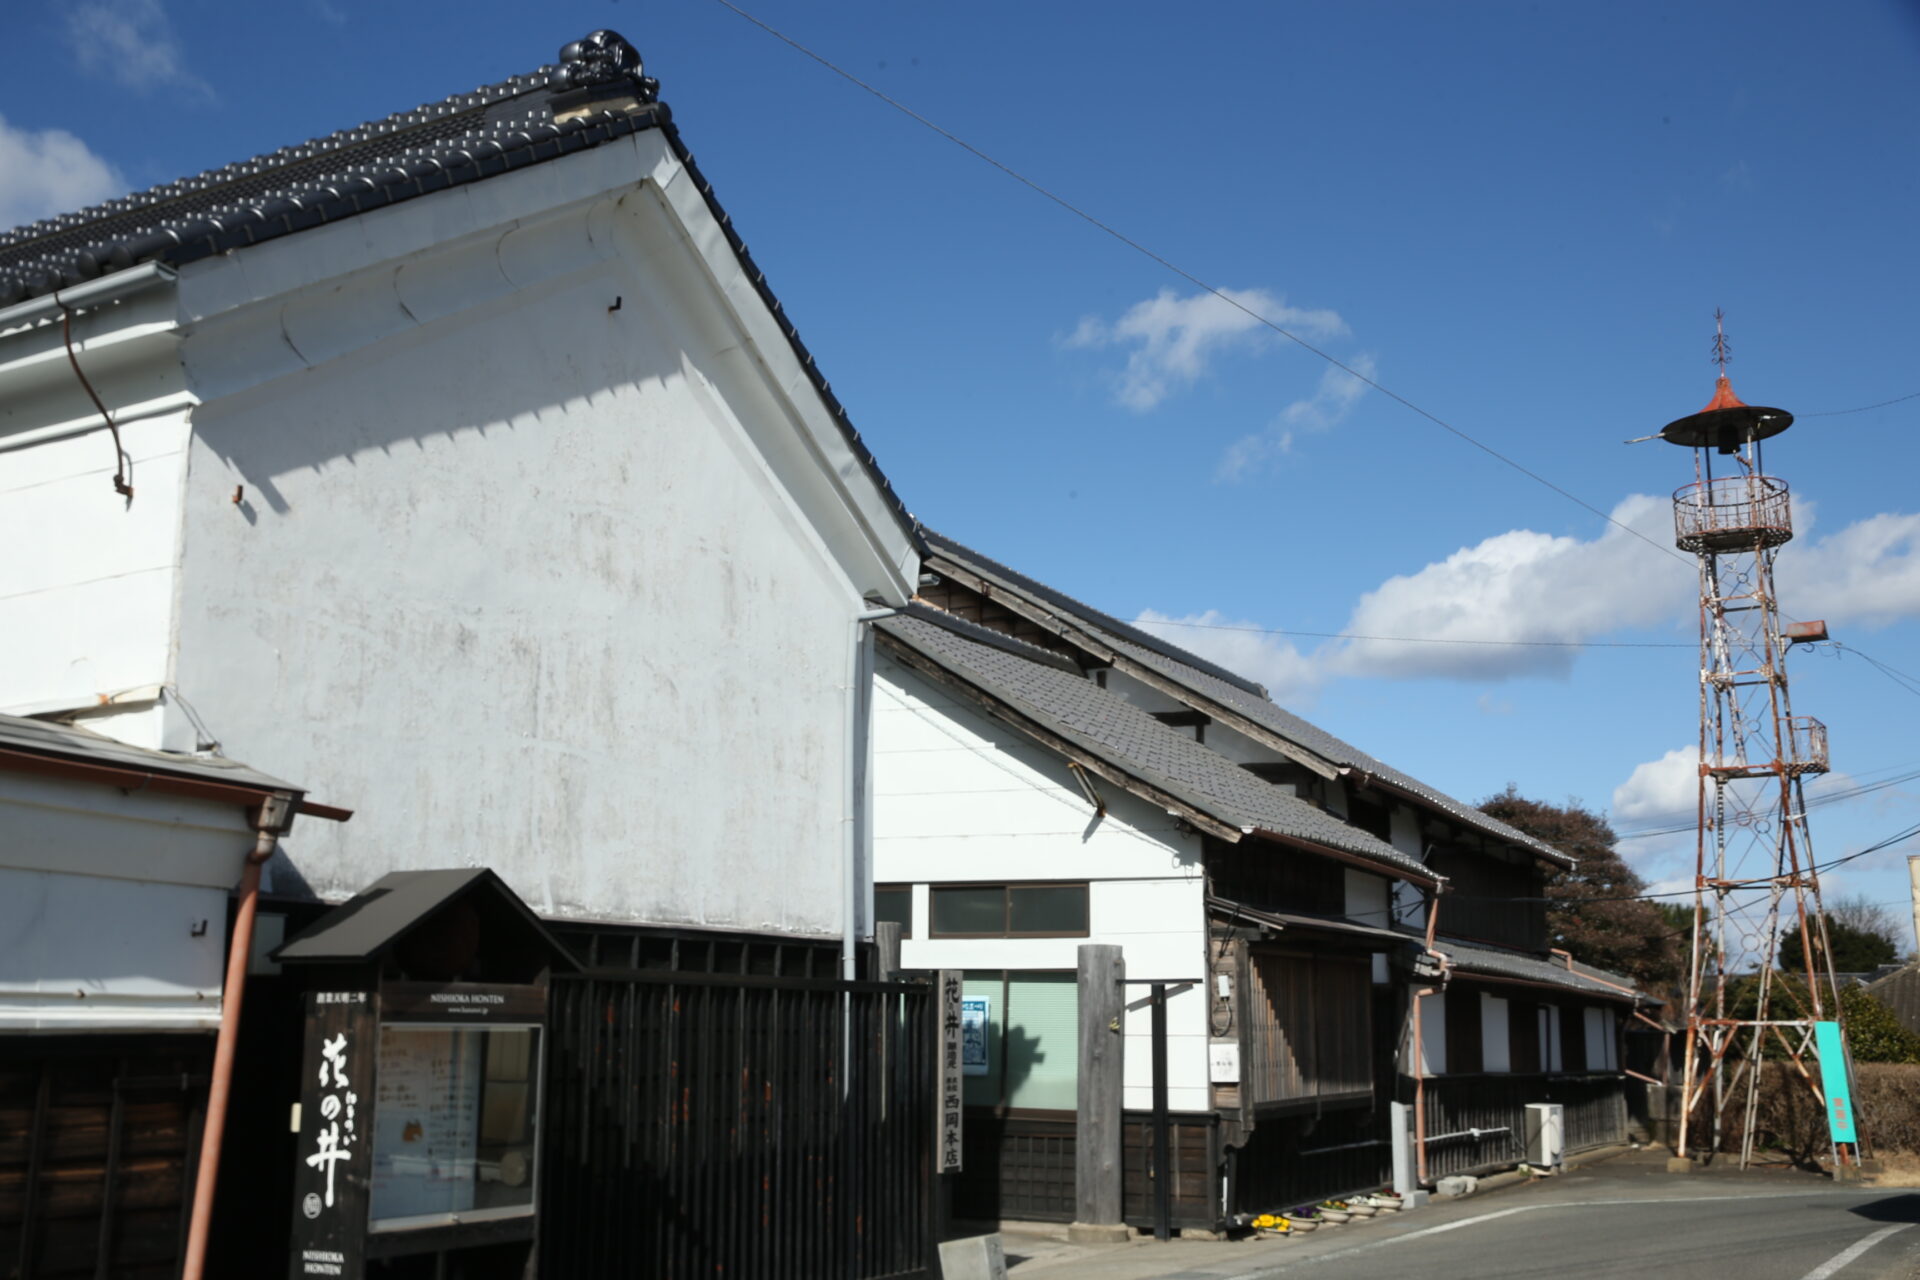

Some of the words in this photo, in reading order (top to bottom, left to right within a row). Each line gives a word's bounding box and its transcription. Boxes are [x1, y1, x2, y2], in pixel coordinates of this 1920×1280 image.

[430, 993, 470, 1004] NISHIOKA
[471, 993, 504, 1004] HONTEN
[306, 1032, 352, 1208] 花の井
[944, 1094, 960, 1166] 西岡本店
[303, 1250, 345, 1263] NISHIOKA
[304, 1262, 342, 1275] HONTEN
